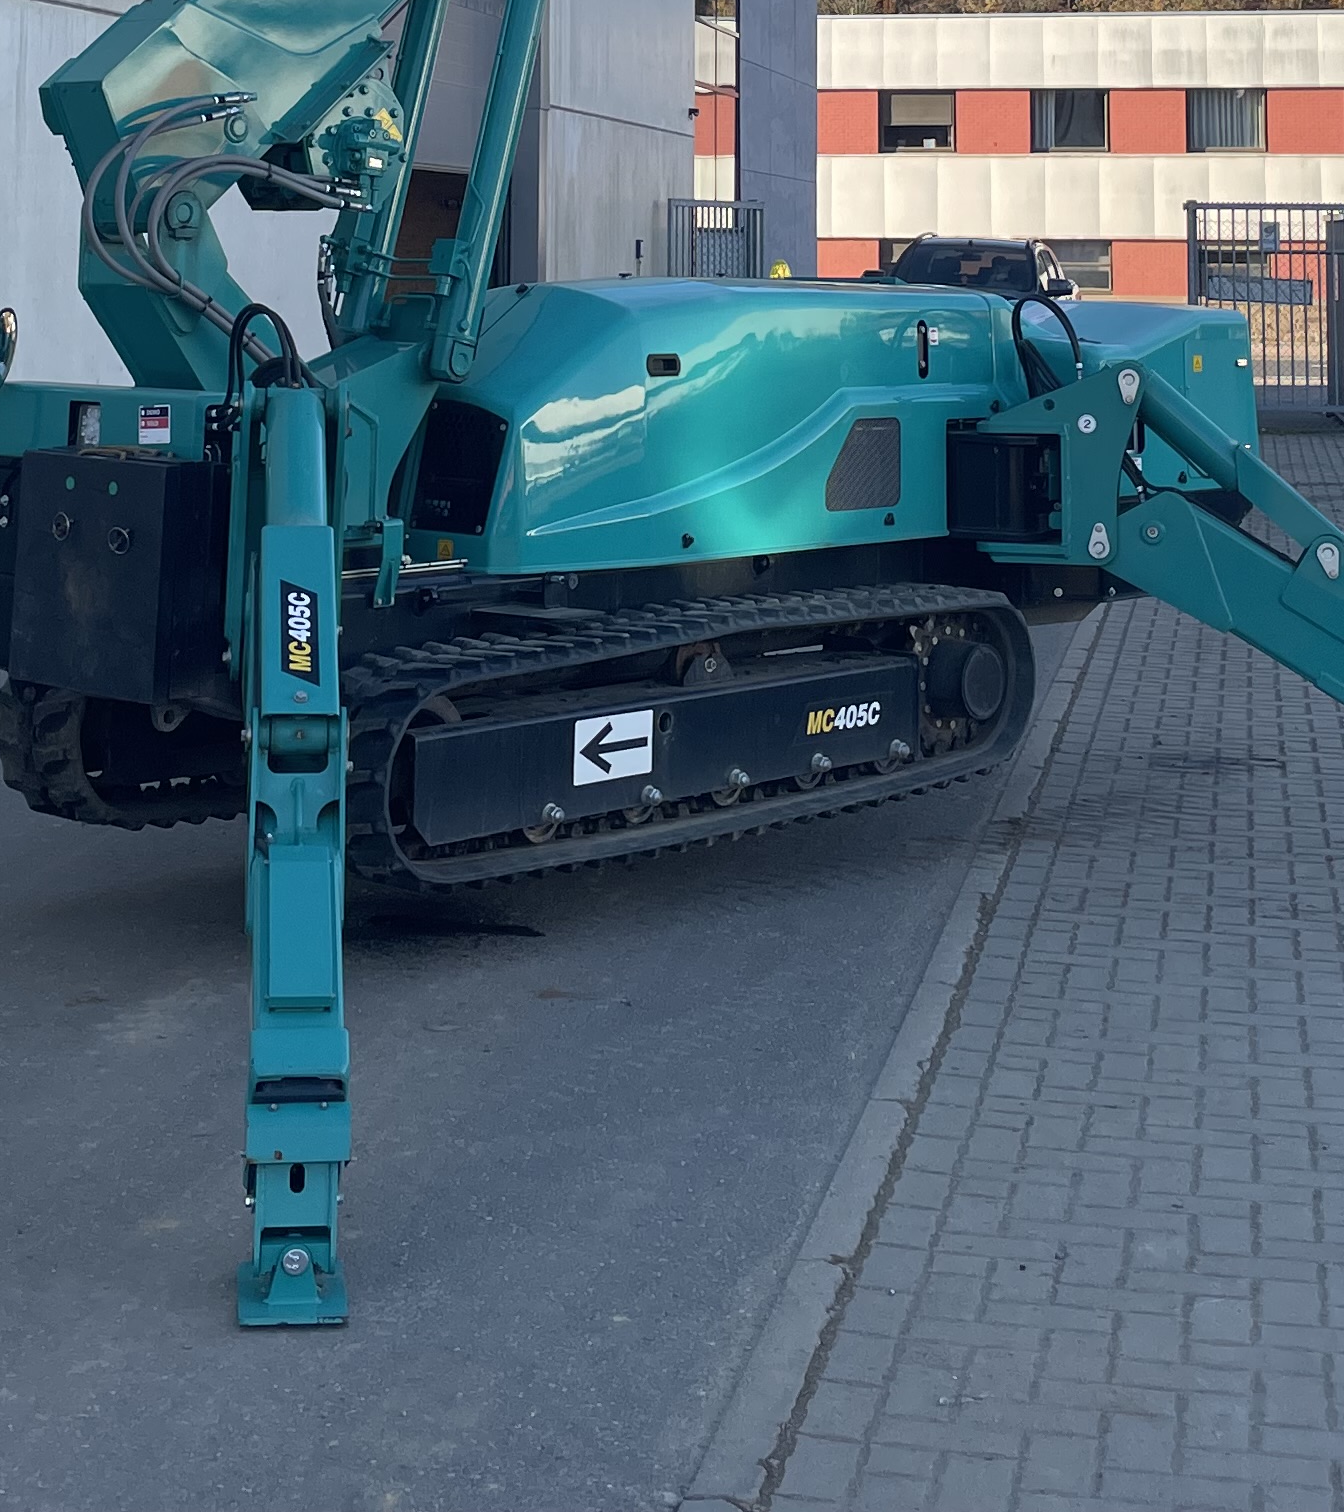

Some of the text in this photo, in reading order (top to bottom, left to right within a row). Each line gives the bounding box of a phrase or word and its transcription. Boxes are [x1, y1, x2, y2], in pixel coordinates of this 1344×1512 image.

[1084, 419, 1091, 429] 2
[288, 592, 312, 672] MC405C
[806, 701, 881, 735] MC405C
